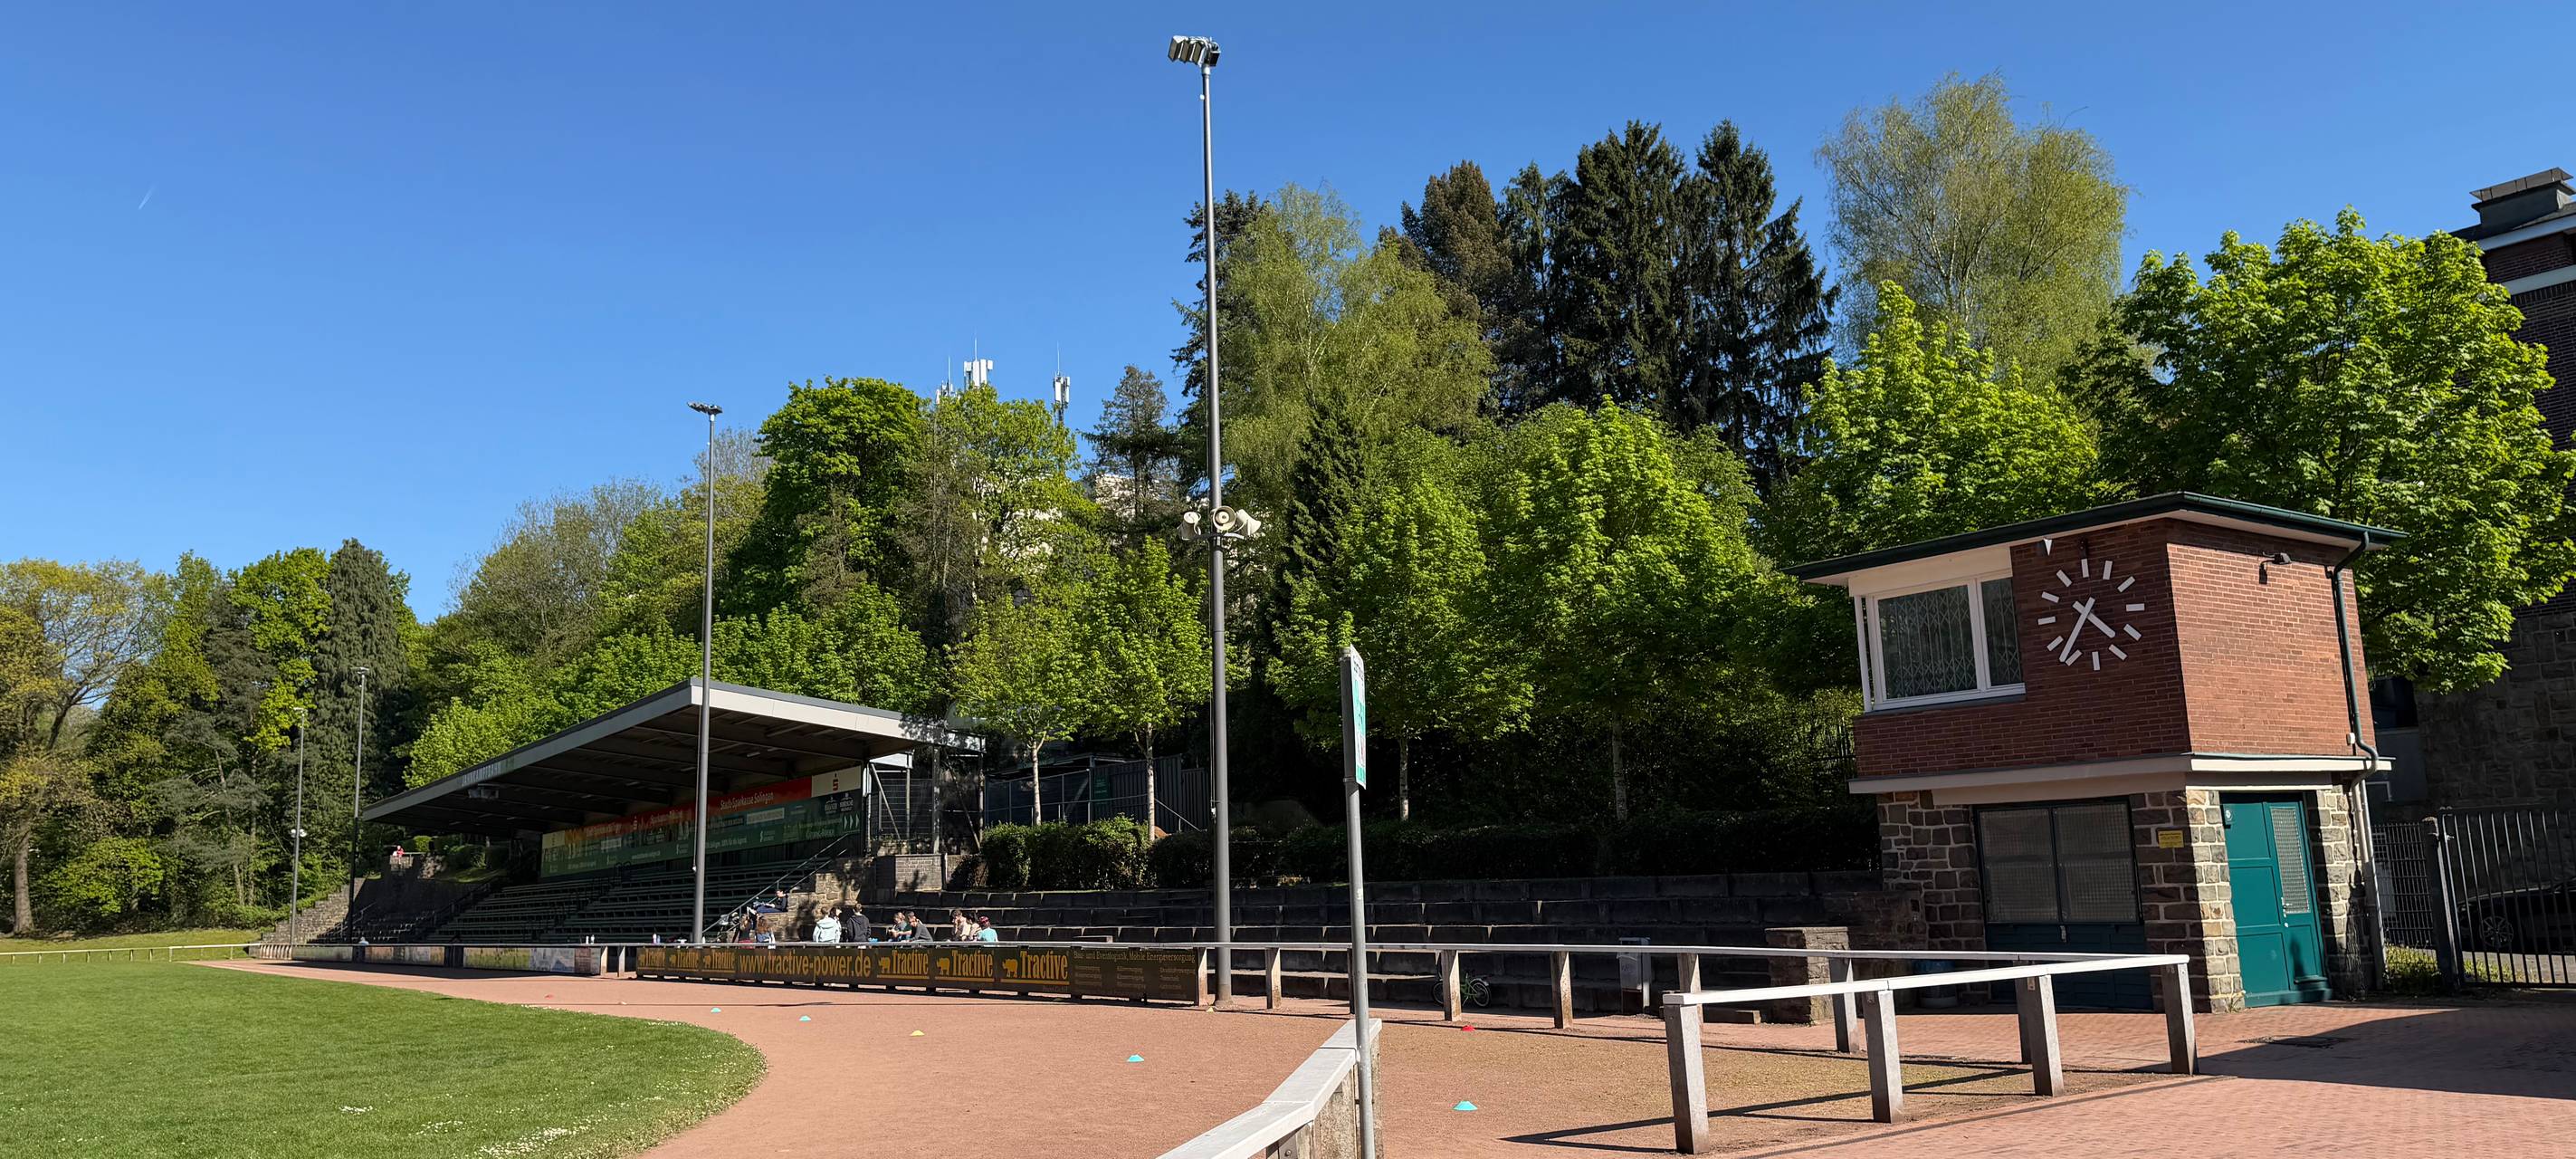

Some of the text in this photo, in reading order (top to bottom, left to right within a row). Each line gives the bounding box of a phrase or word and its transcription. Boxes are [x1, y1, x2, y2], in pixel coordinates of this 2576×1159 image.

[754, 791, 774, 804] Solingen
[677, 950, 699, 968] Tractive
[712, 950, 734, 969] Tractive
[739, 950, 871, 982] www.tractive-power.de
[892, 950, 929, 975] Tractive
[952, 950, 993, 977] Tractive
[1020, 951, 1068, 979] Tractive
[1129, 952, 1146, 961] Mobile
[1147, 952, 1195, 964] Energieversorgung
